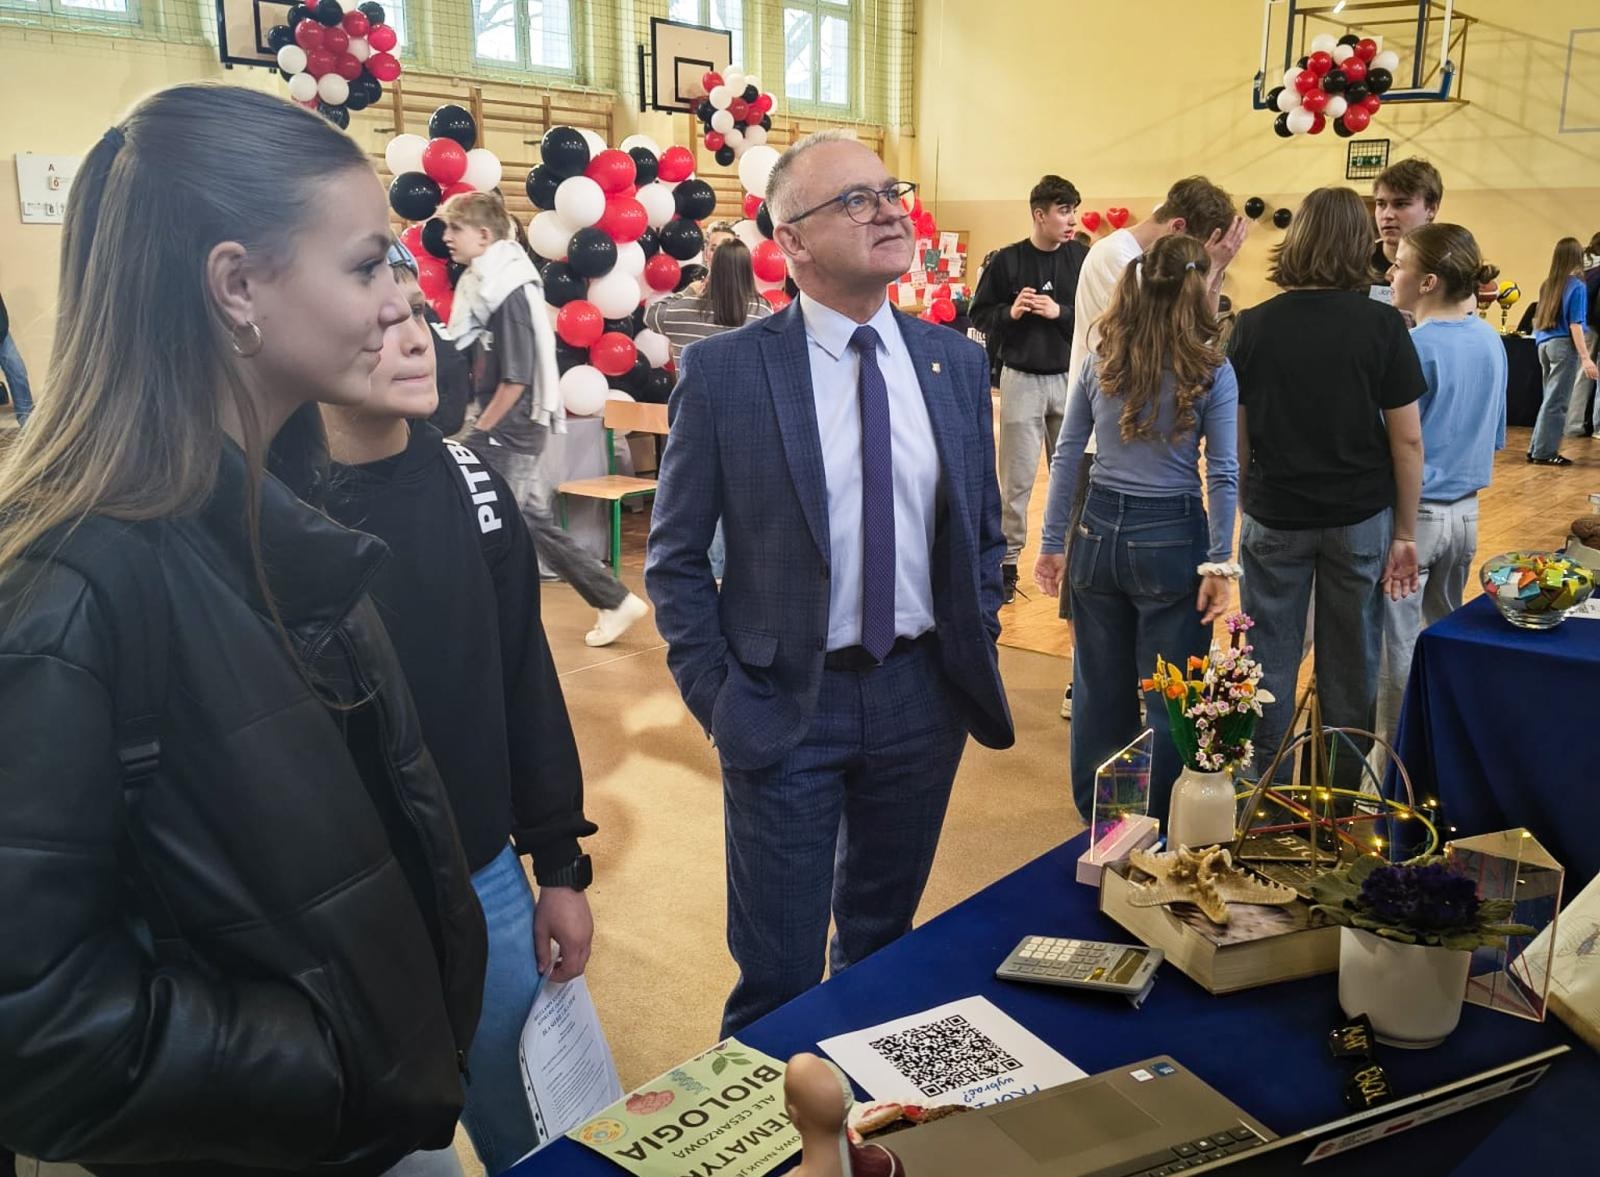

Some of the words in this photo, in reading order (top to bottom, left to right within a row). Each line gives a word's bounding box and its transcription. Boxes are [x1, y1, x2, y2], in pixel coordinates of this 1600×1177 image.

[442, 438, 502, 534] PITB
[614, 1064, 783, 1161] BIOLOGIA
[672, 1109, 754, 1159] CESARZOWĄ
[752, 1093, 776, 1110] ALE
